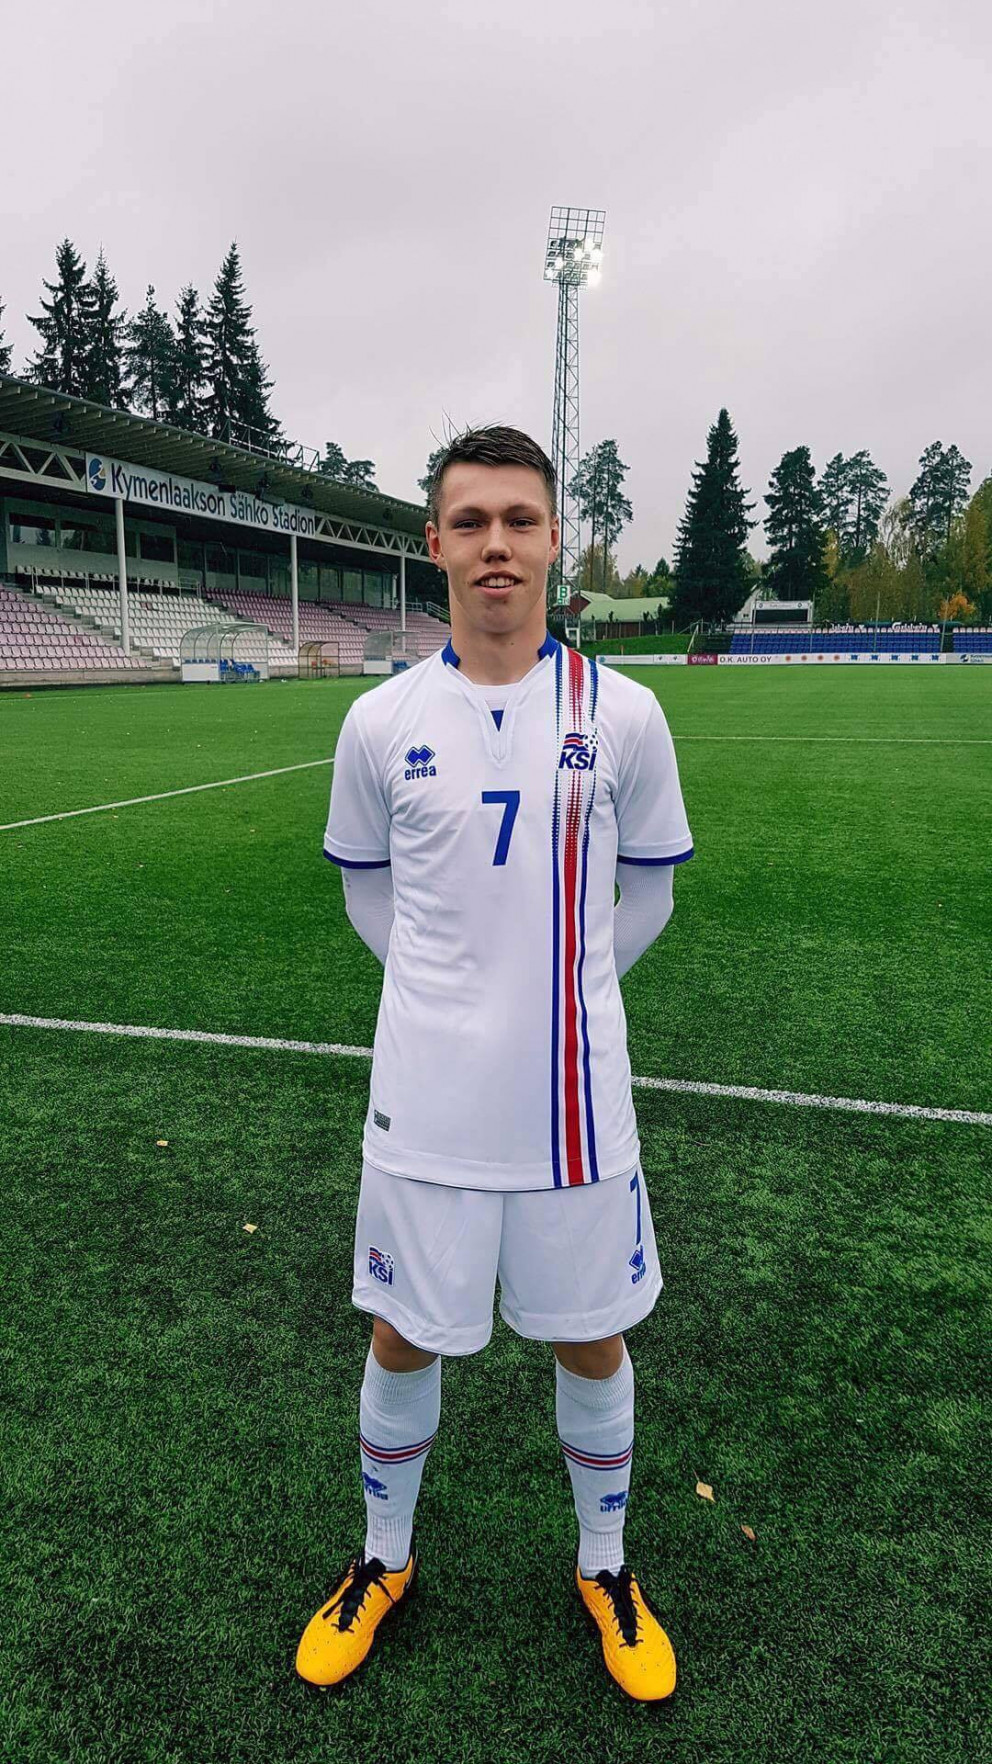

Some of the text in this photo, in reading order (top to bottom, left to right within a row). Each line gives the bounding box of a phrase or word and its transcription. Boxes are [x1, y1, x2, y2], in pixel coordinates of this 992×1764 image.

[111, 462, 226, 517] Kymenlaakson
[272, 506, 315, 536] Stadion
[481, 790, 520, 866] 7
